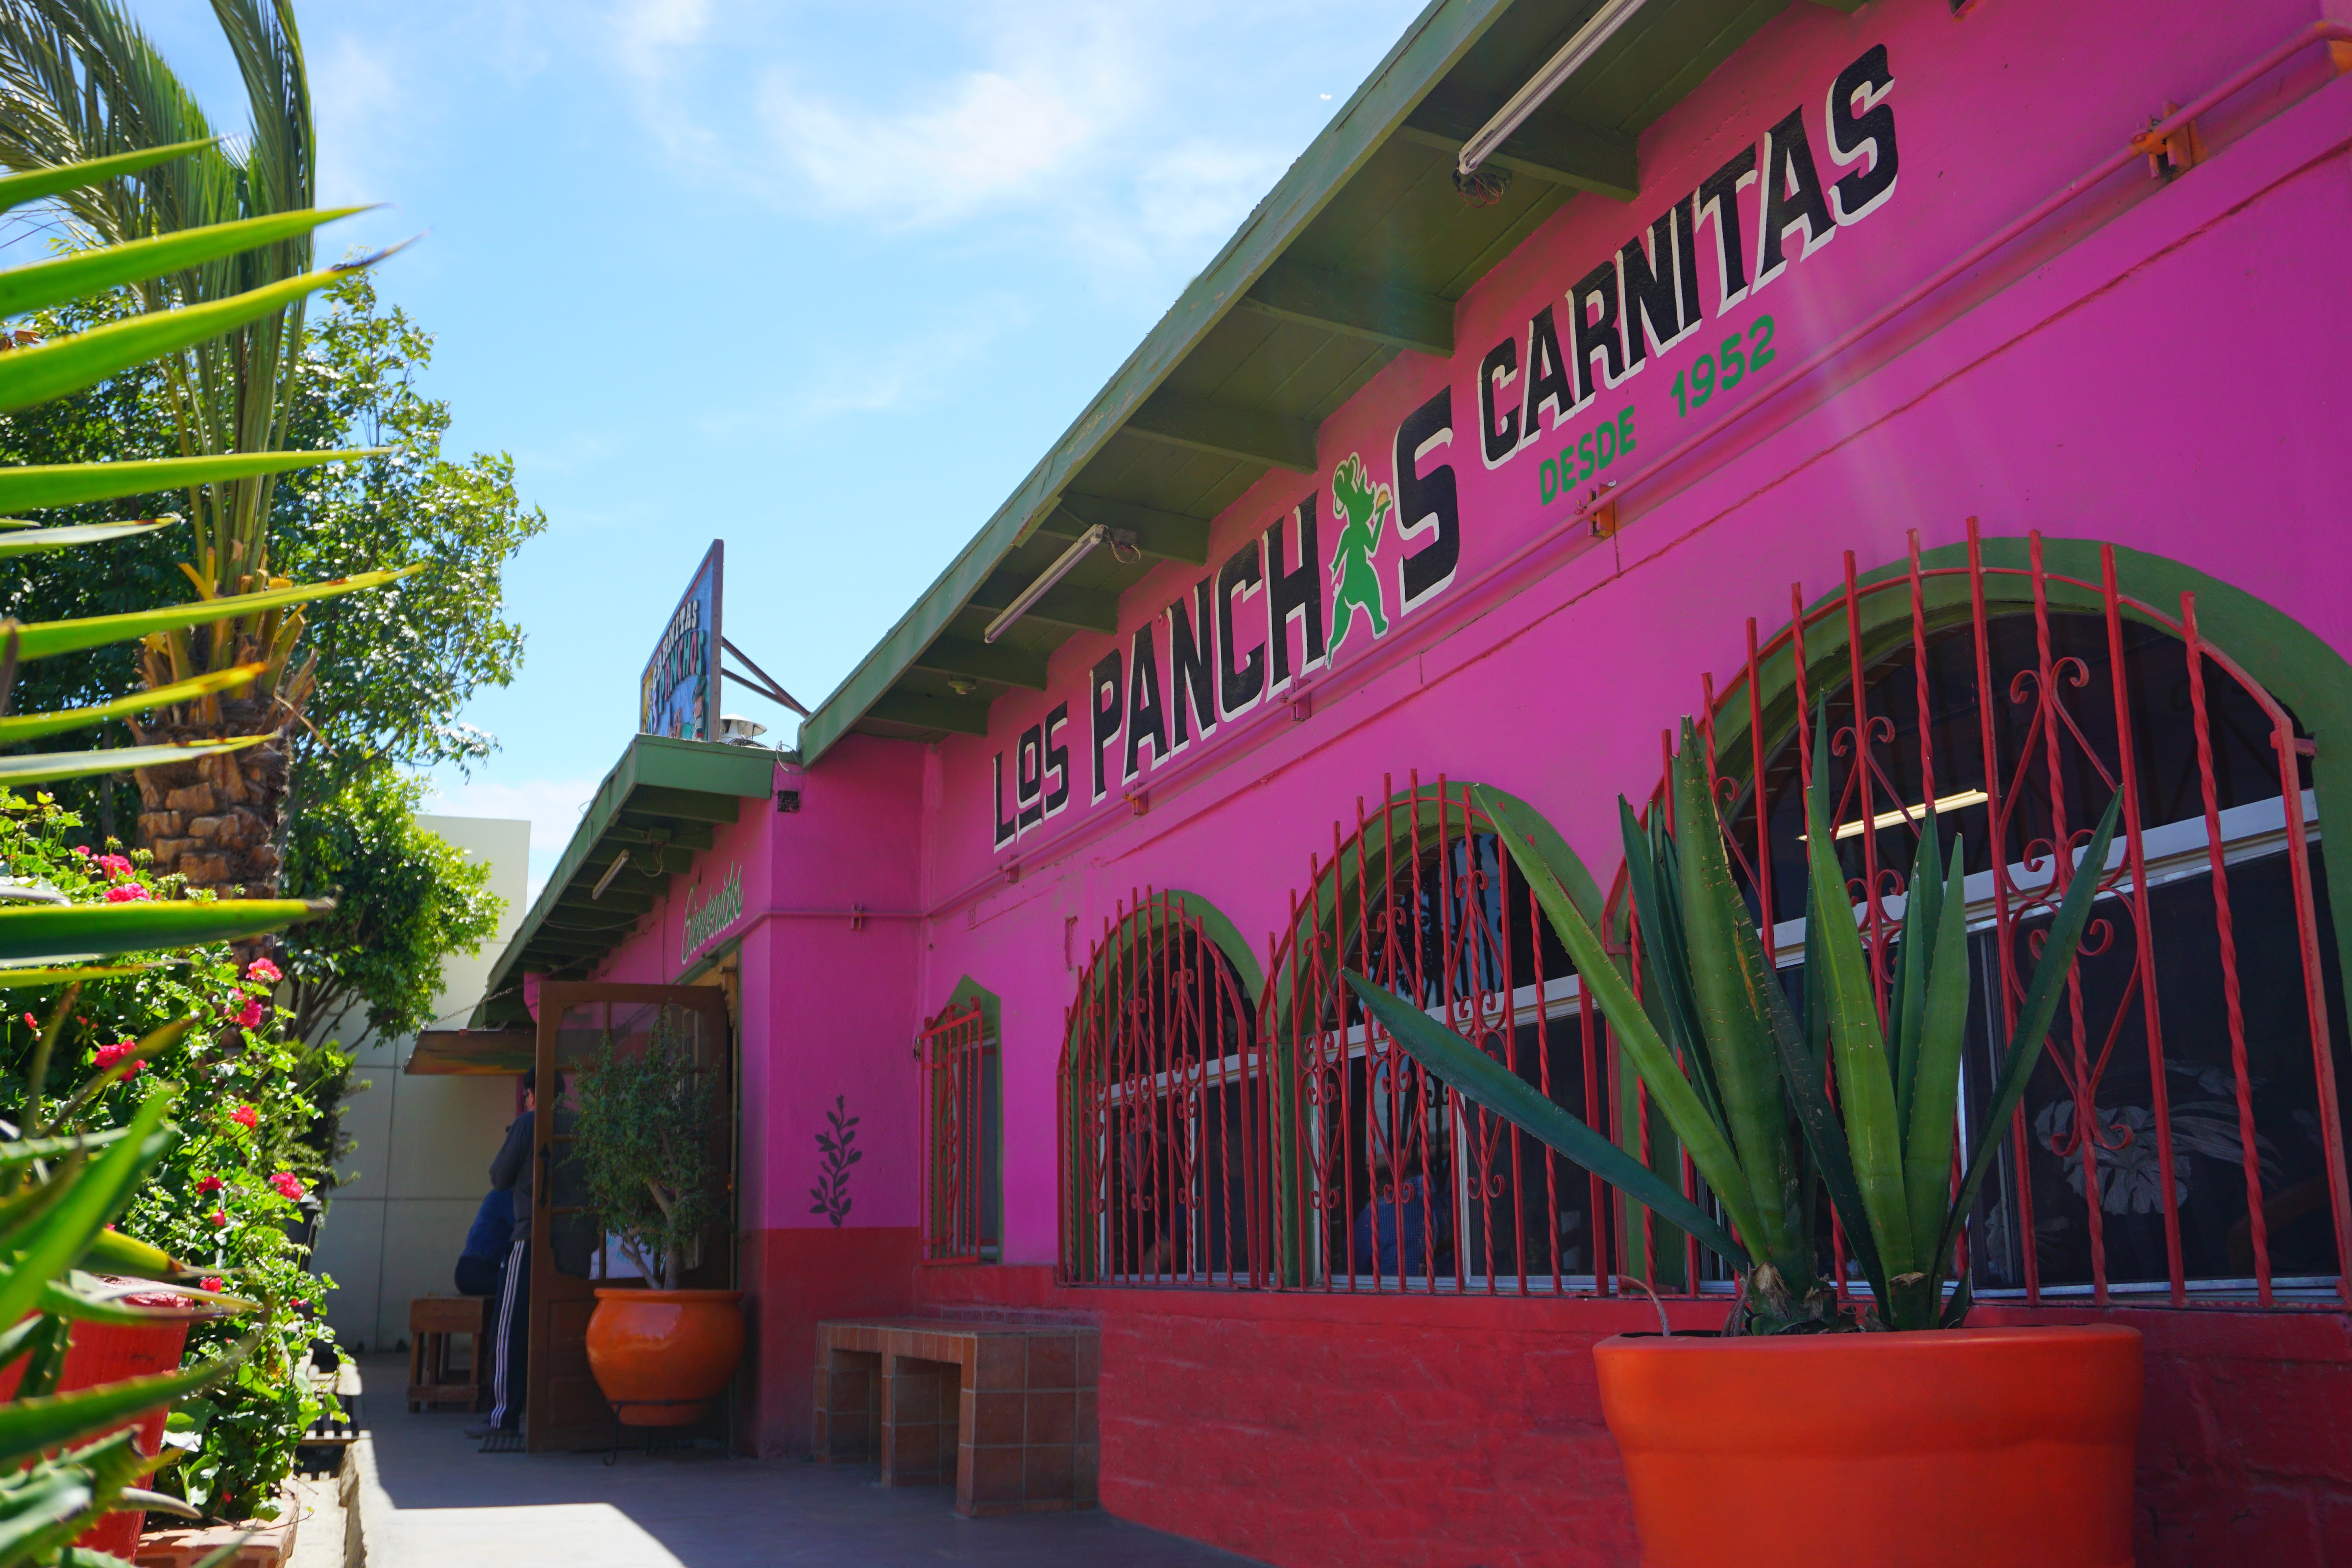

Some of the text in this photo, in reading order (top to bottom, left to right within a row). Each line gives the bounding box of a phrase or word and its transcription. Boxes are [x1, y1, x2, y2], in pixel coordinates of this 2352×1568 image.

[992, 43, 1899, 854] LOS PANCHS CARNITAS
[1538, 314, 1777, 507] DESDE 1952
[652, 599, 699, 693] CARNITAS
[659, 630, 706, 715] PANCHOS
